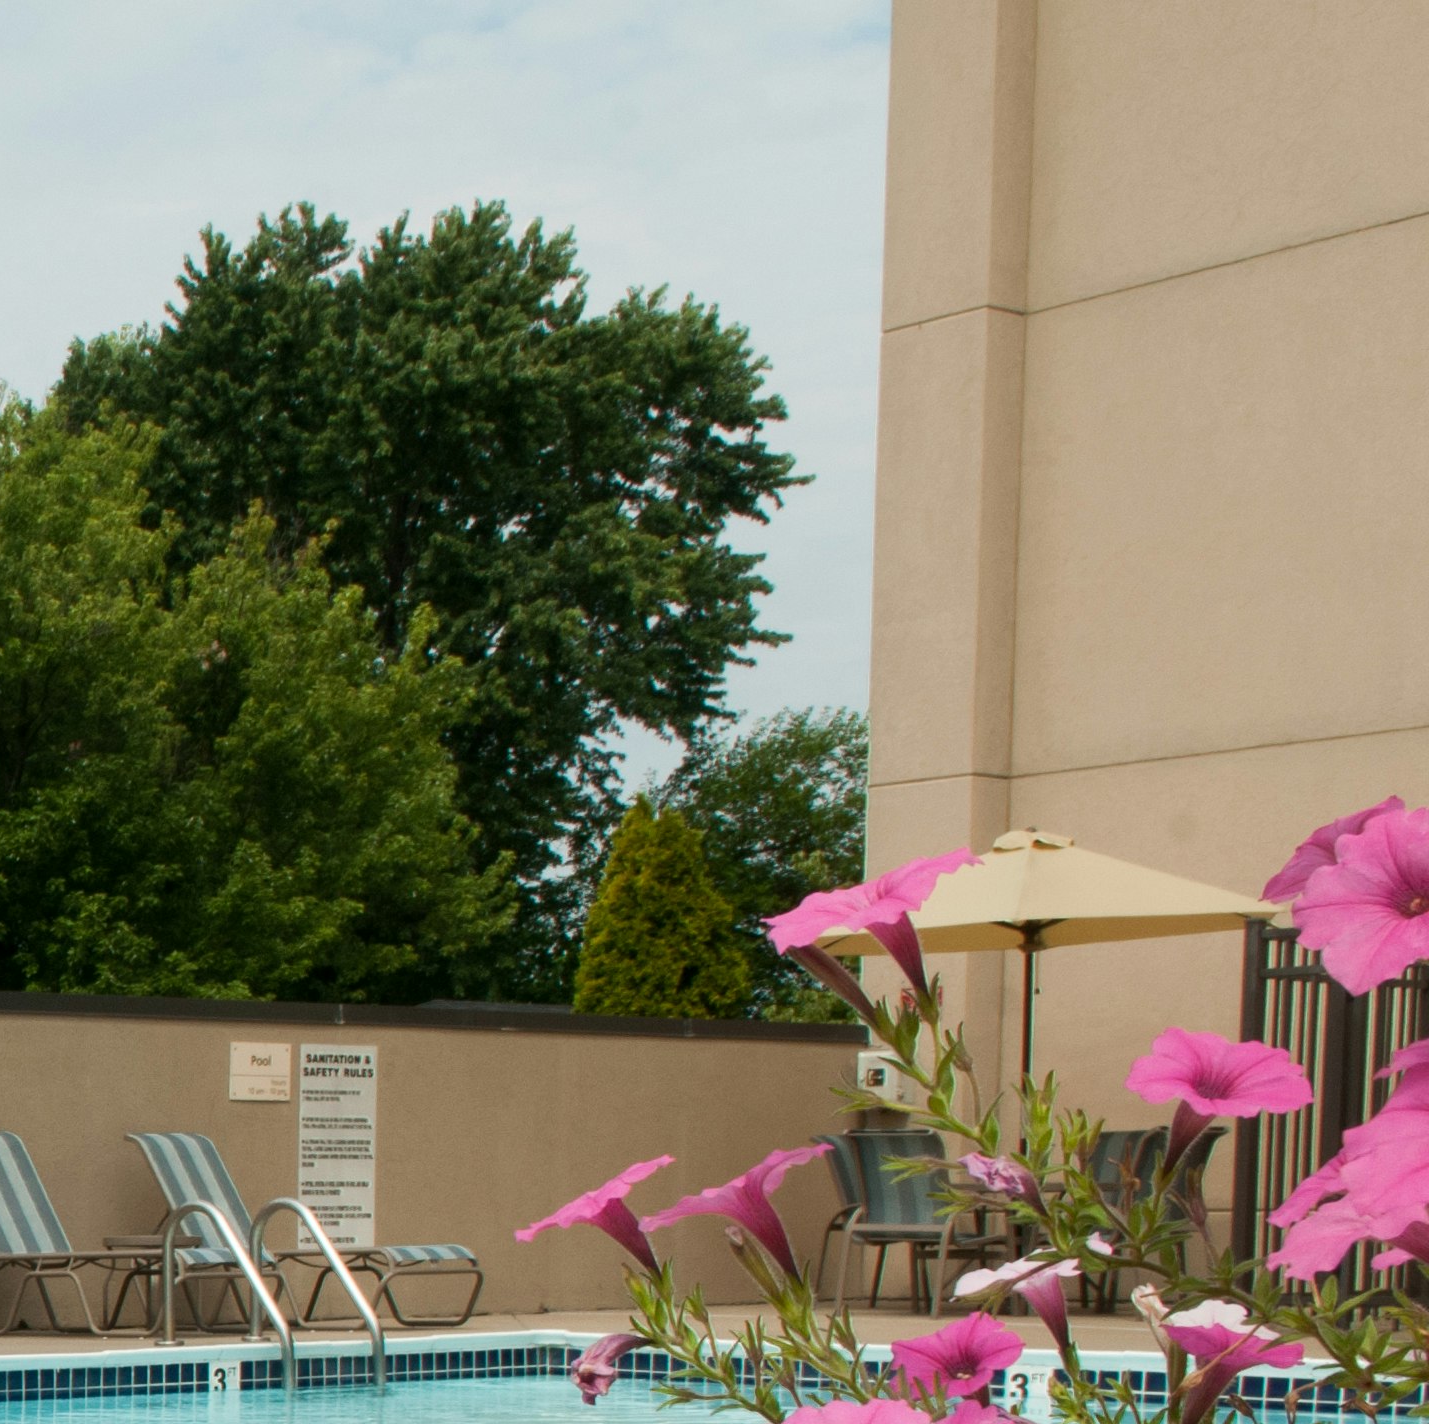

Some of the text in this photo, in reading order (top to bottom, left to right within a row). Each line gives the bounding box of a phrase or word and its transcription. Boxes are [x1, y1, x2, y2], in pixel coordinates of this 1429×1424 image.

[250, 1055, 272, 1066] Pool
[305, 1053, 362, 1065] SANITATION
[303, 1067, 374, 1078] SAFETY RULES
[214, 1368, 226, 1391] 3
[1010, 1373, 1029, 1399] 3
